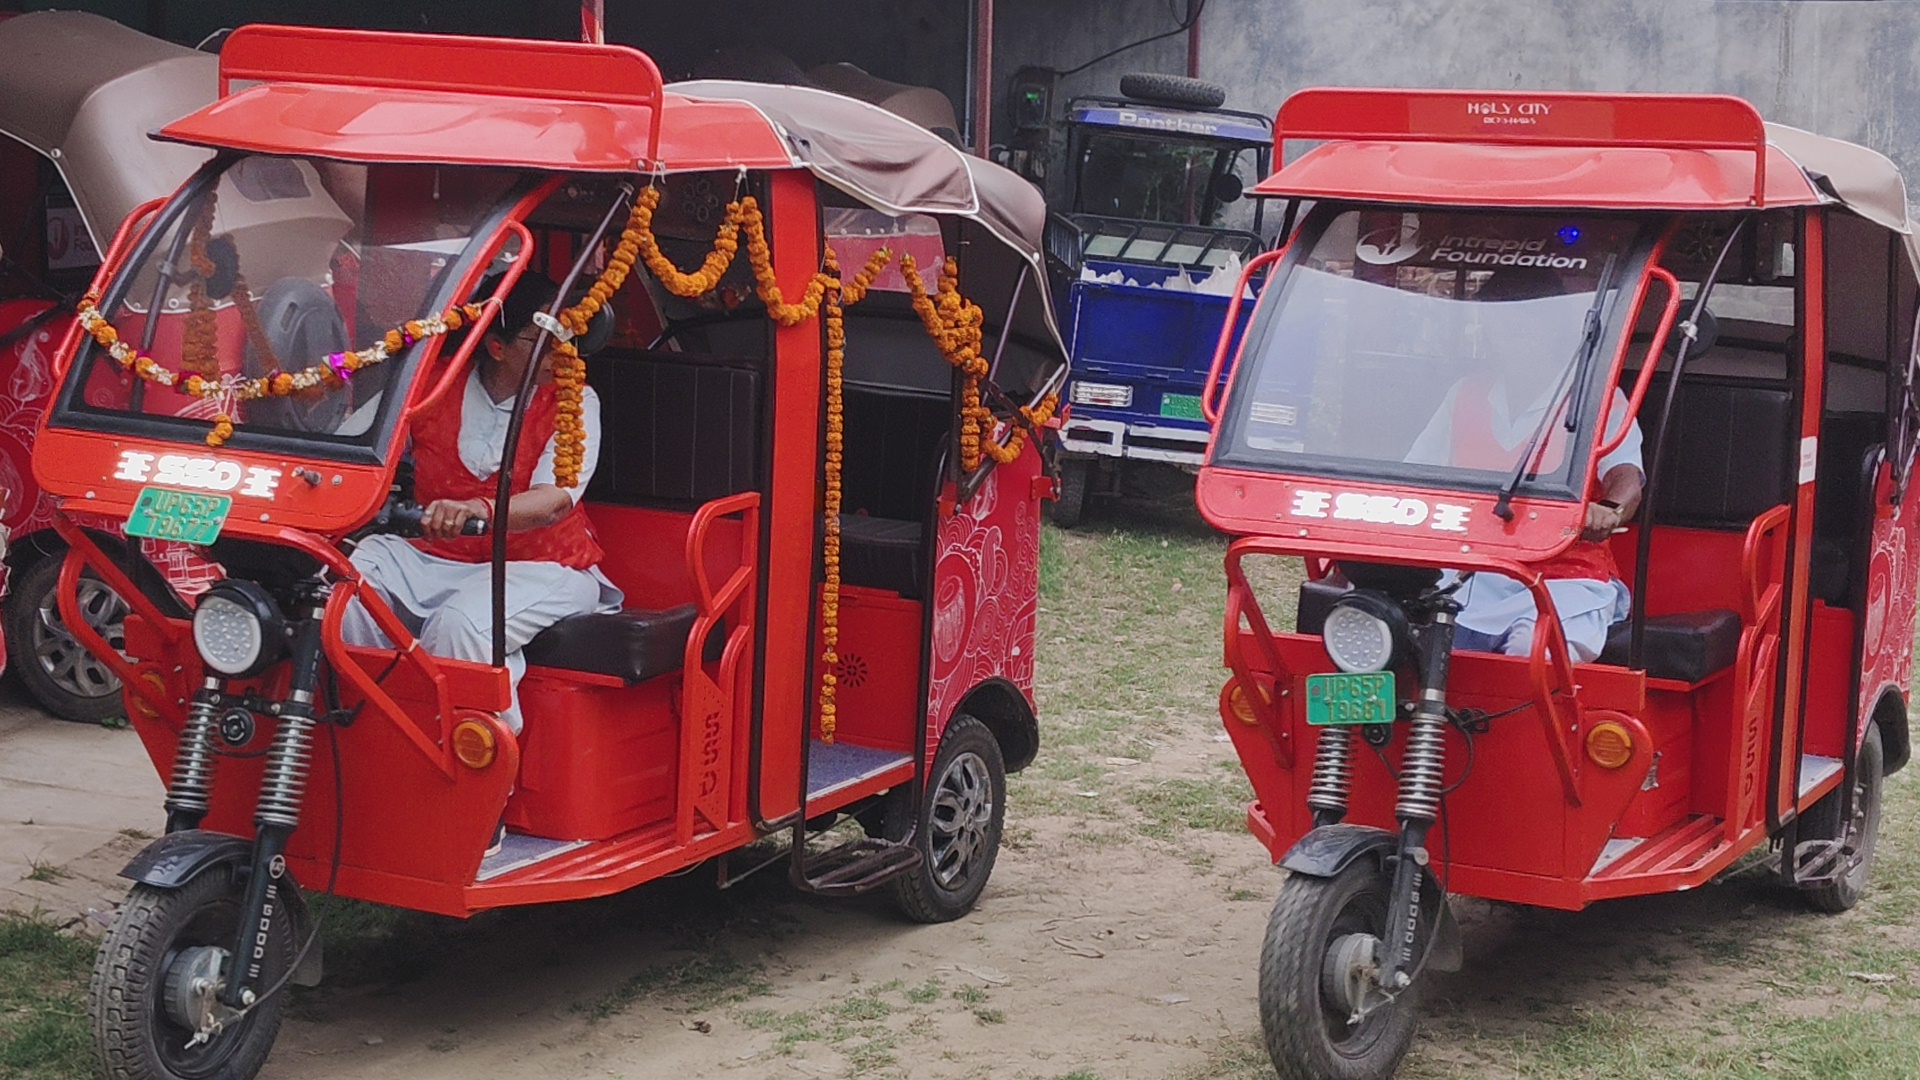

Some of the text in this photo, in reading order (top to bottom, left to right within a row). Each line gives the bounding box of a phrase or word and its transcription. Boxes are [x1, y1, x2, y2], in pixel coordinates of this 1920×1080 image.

[1467, 102, 1552, 115] HOLY CITY
[1438, 234, 1548, 253] Intrepid
[1430, 247, 1588, 269] Foundation
[154, 490, 221, 517] UP65P
[1323, 675, 1387, 698] UP65P
[253, 903, 275, 960] GOOD
